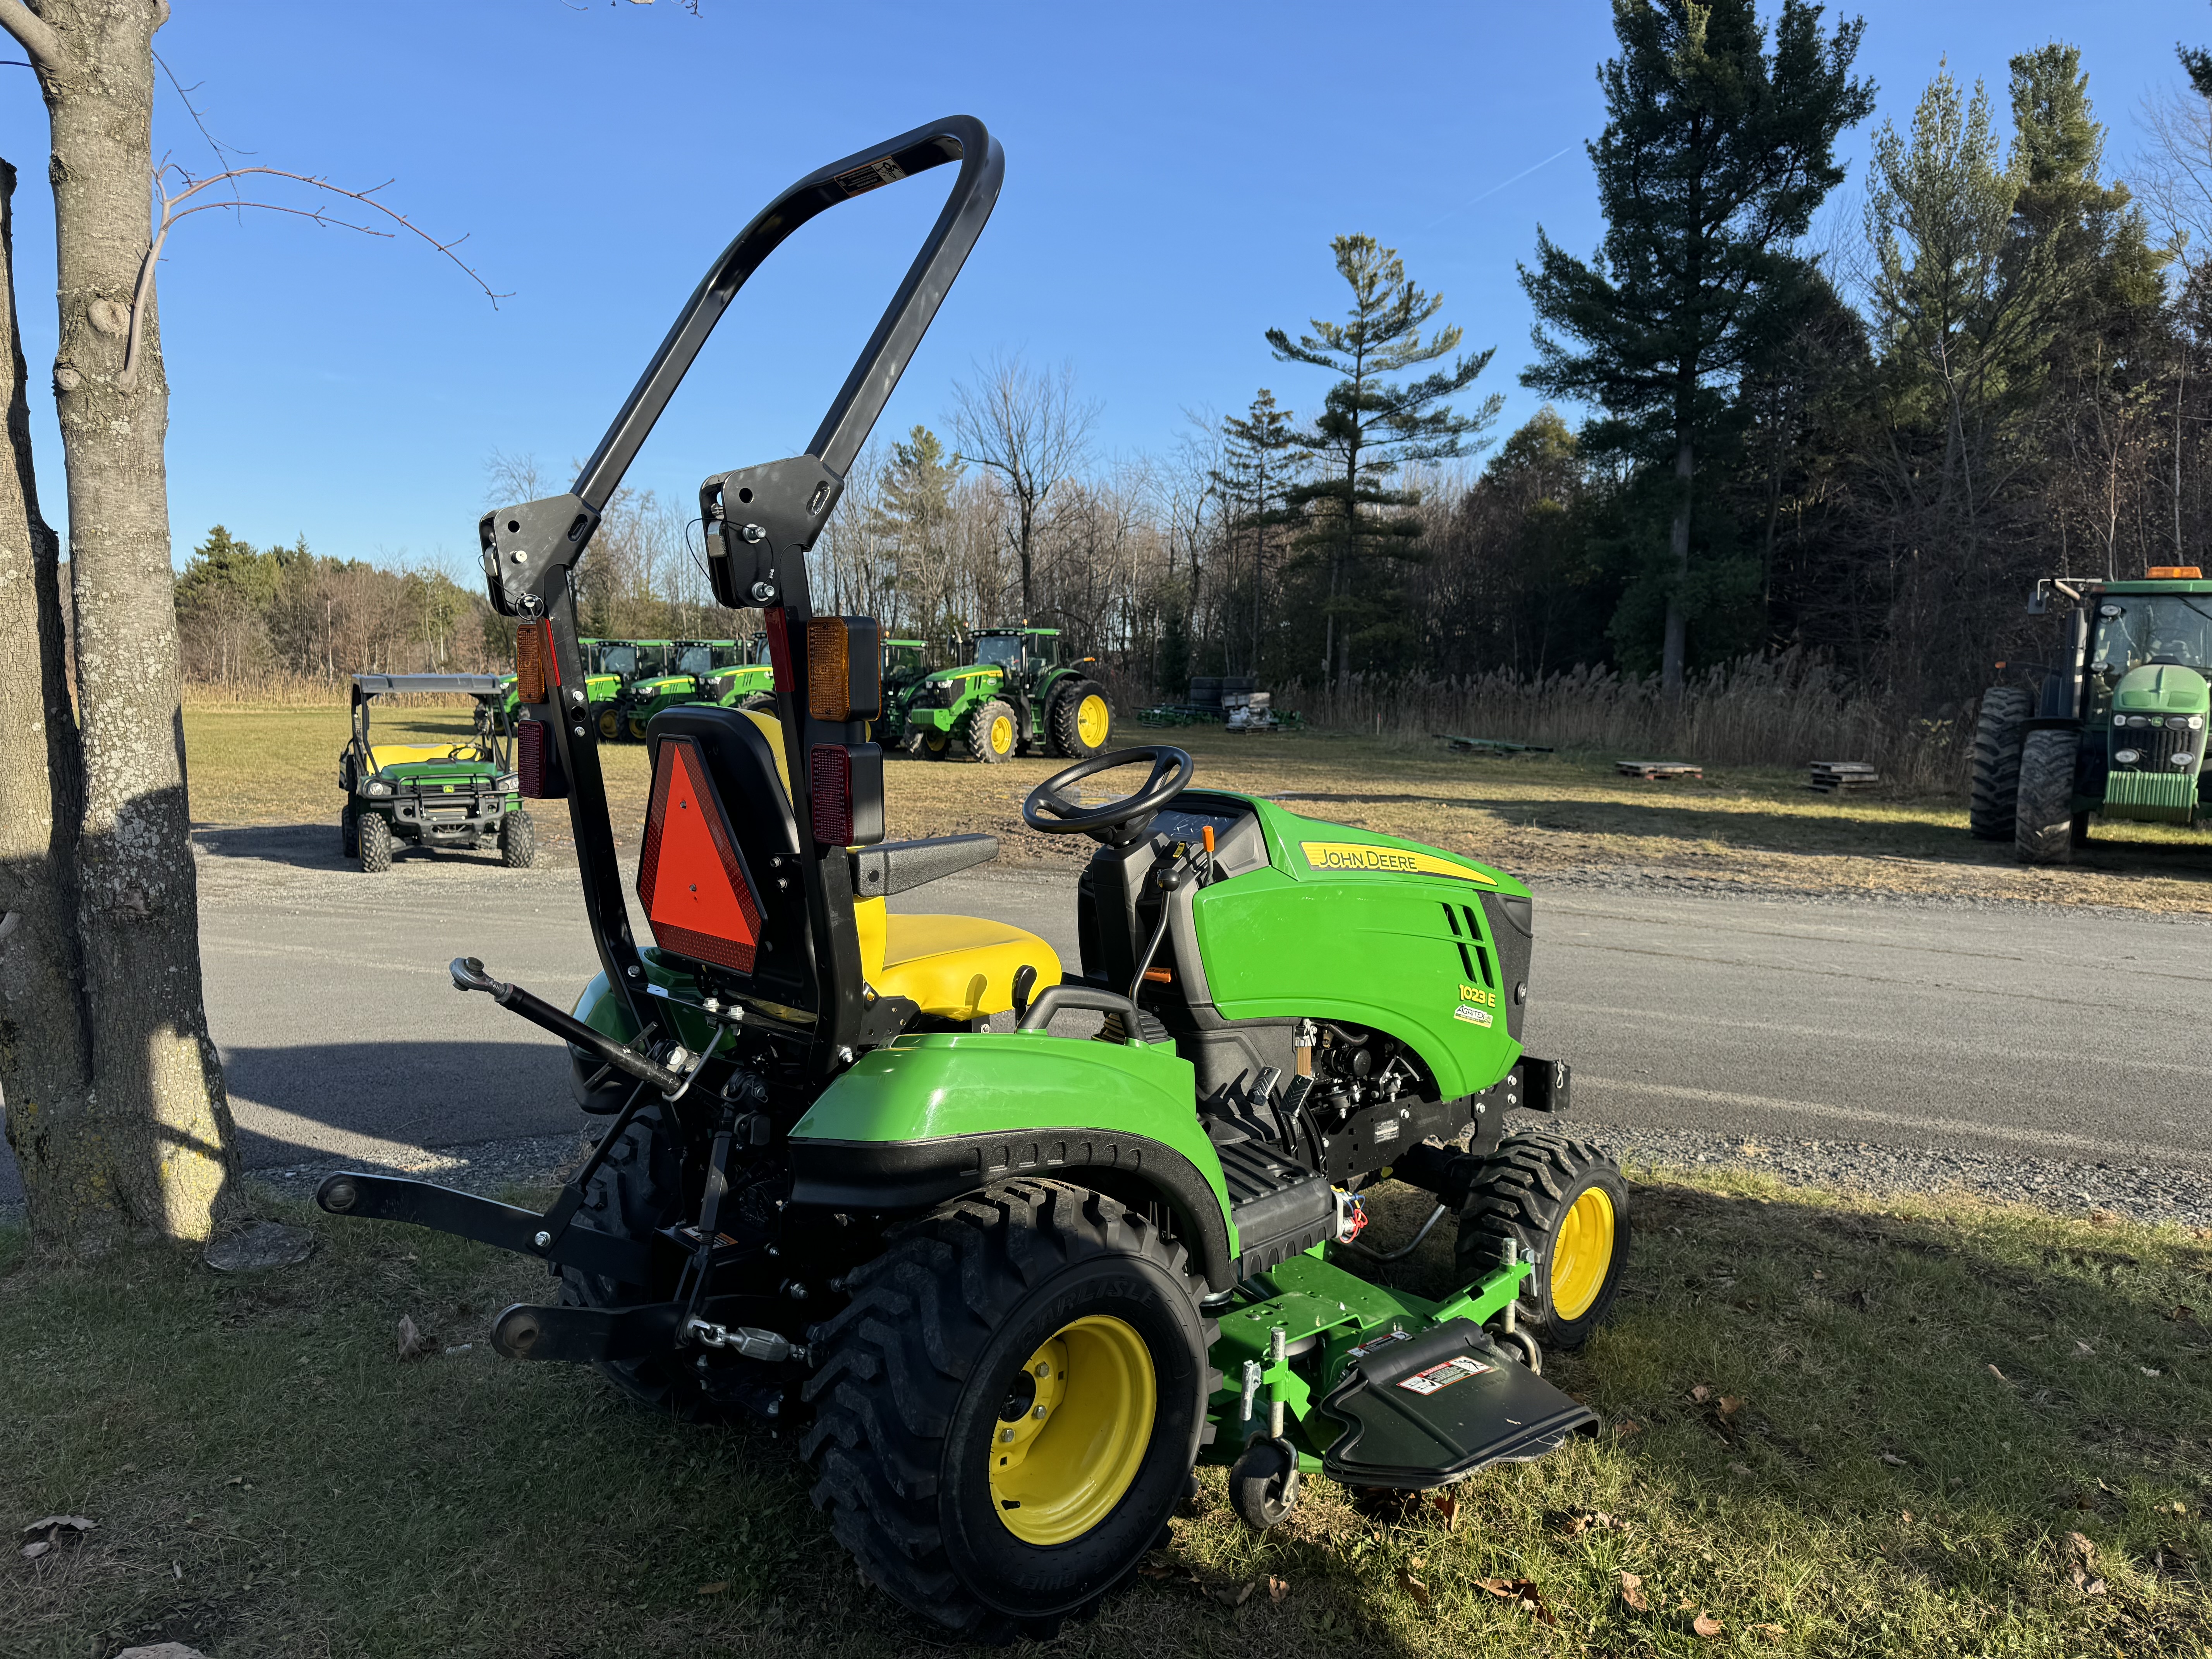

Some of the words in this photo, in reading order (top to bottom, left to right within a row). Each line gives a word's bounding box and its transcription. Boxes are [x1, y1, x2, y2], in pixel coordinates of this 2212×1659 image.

[1320, 849, 1364, 866] JOHN
[1366, 851, 1418, 870] DEERE
[1459, 984, 1486, 1004] 1023
[1488, 993, 1496, 1008] E
[1456, 1005, 1485, 1019] AGRITEX
[1017, 1278, 1160, 1354] CARLISLE
